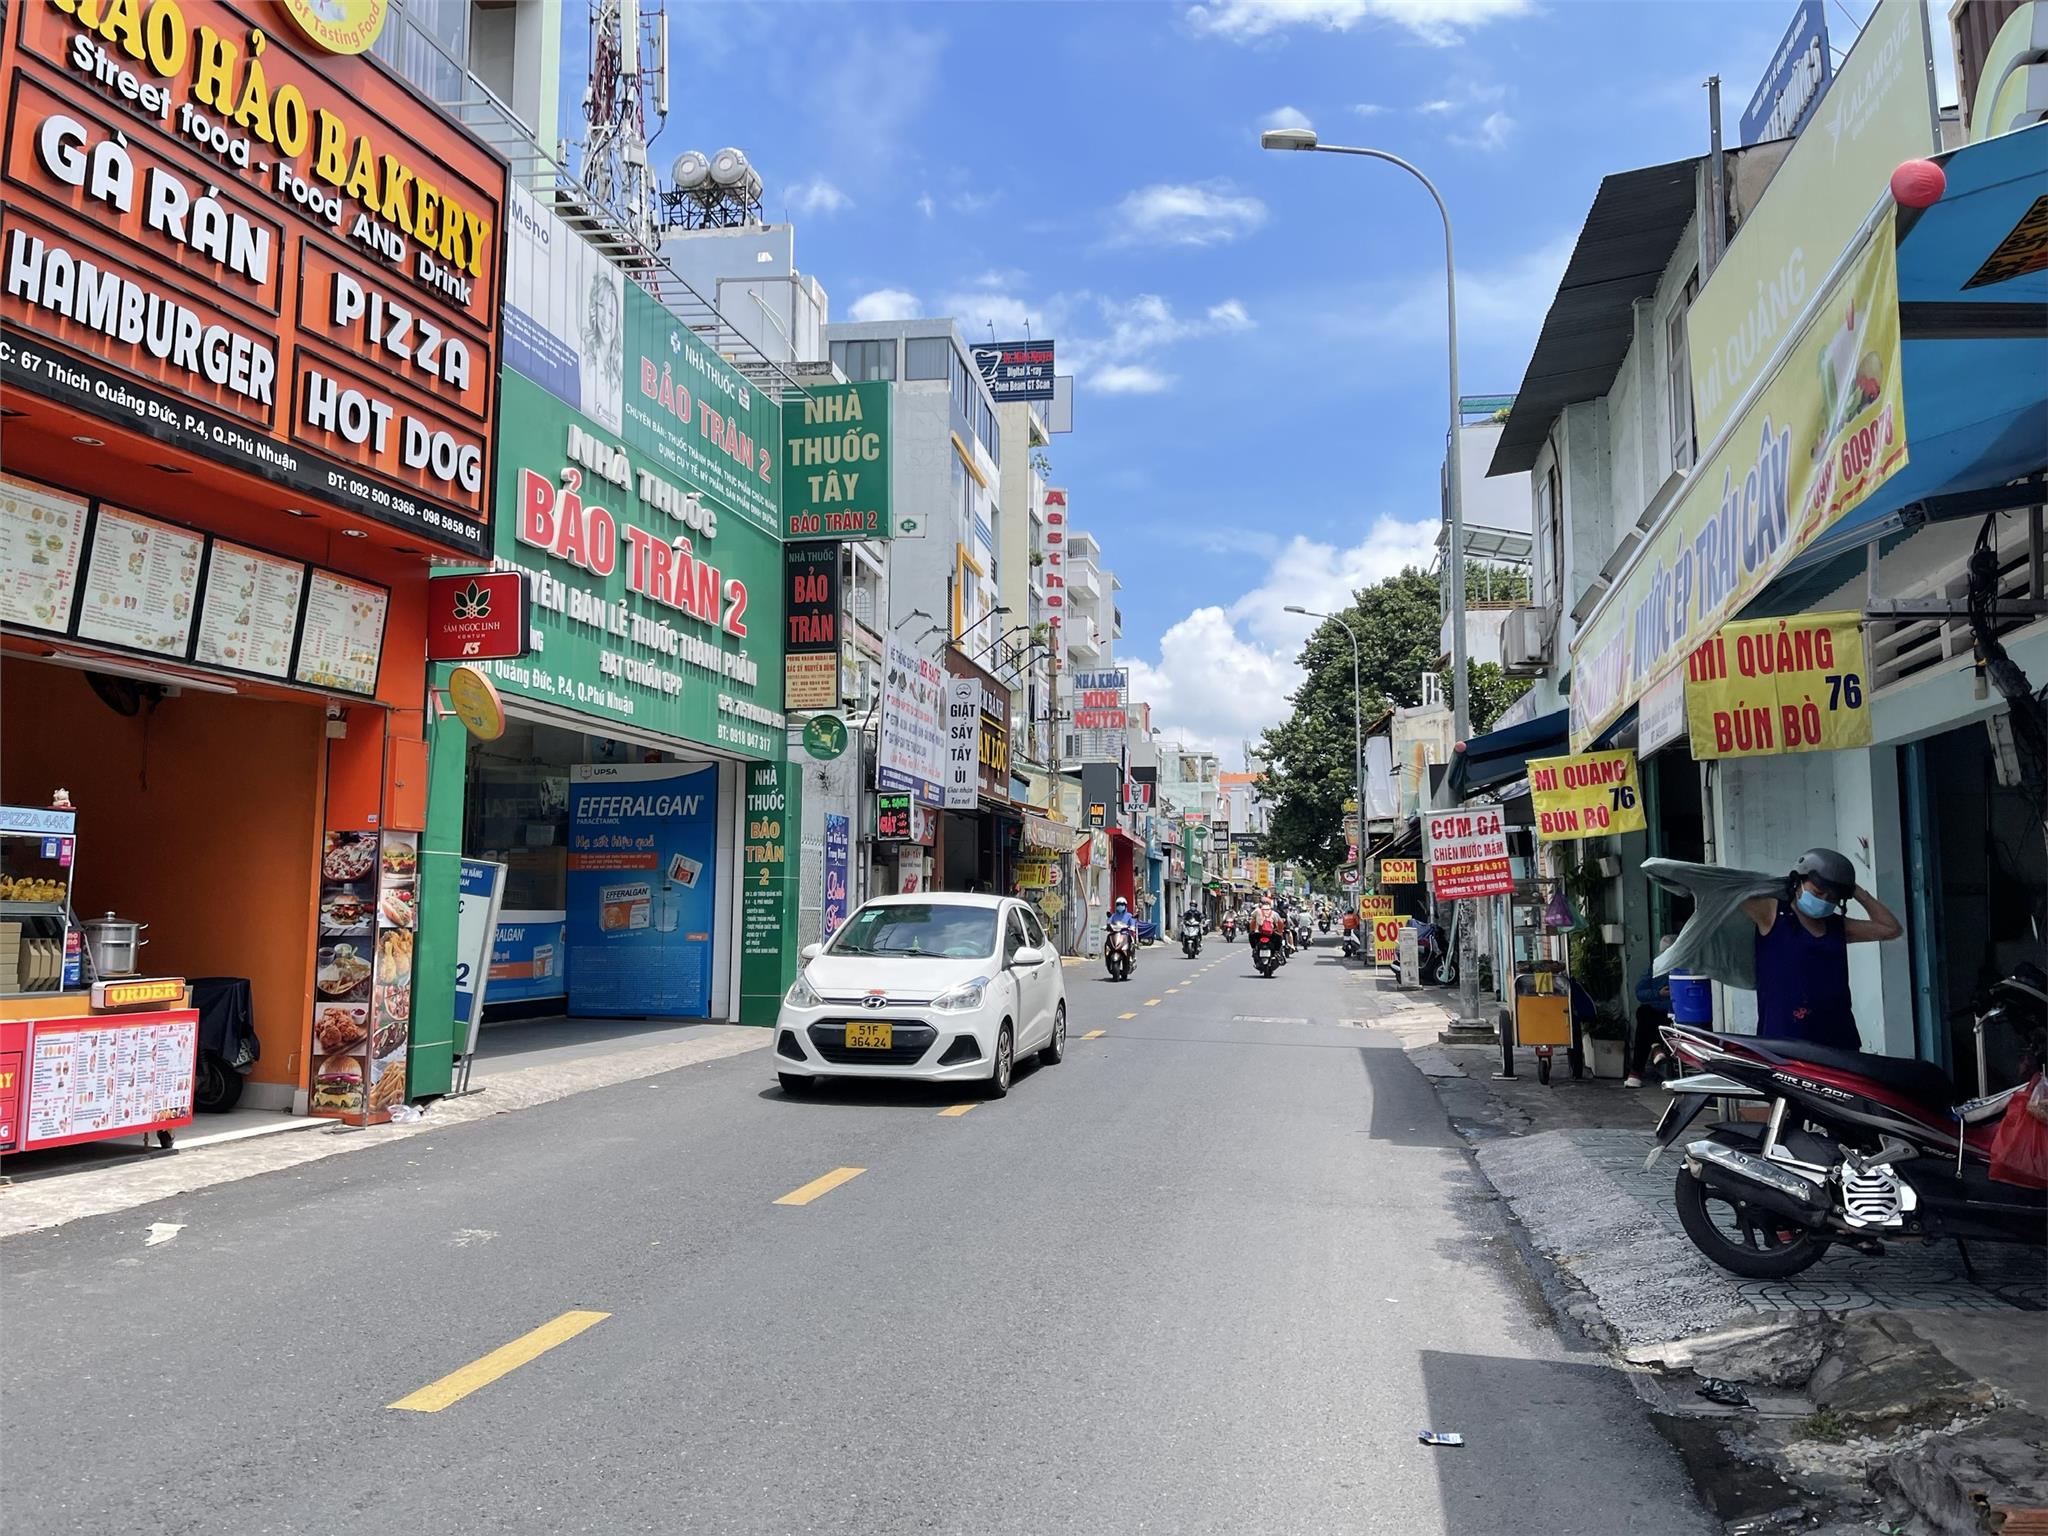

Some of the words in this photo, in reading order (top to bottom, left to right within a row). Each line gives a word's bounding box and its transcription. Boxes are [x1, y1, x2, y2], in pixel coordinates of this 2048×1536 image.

[313, 15, 360, 48] Tasting
[358, 0, 380, 39] Food
[195, 28, 308, 159] HẢO
[317, 109, 490, 279] BAKERY
[73, 33, 171, 119] Street
[182, 103, 250, 170] food
[278, 164, 342, 226] Food
[352, 211, 407, 264] AND
[419, 252, 471, 306] Drink
[39, 114, 135, 213] GÀ
[149, 167, 270, 285] RÁN
[8, 228, 276, 406] HAMBURGER
[334, 272, 470, 391] PIZZA
[685, 344, 706, 375] NHÀ
[706, 362, 736, 400] THUỐC
[1007, 366, 1025, 378] Digital
[1035, 379, 1051, 390] Scan
[21, 353, 42, 372] 67
[46, 360, 90, 394] Thích
[95, 379, 146, 418] Quảng
[148, 400, 181, 429] Đức,
[184, 414, 210, 440] P.4,
[213, 426, 254, 456] Q.Phú
[256, 442, 298, 473] Nhuận
[641, 355, 692, 425] BẢO
[697, 399, 754, 472] TRÂN
[758, 448, 772, 484] 2
[805, 389, 863, 425] NHÀ
[308, 371, 393, 452] HOT
[405, 415, 482, 492] DOG
[788, 427, 880, 467] THUỐC
[568, 424, 632, 492] NHÀ
[637, 466, 718, 540] THUỐC
[807, 469, 860, 504] TÂY
[327, 471, 347, 493] ĐT:
[350, 480, 370, 498] 092
[371, 485, 390, 506] 500
[392, 492, 415, 517] 3366
[423, 507, 441, 528] 098
[442, 514, 464, 535] 5858
[465, 523, 481, 541] 051
[1695, 466, 1741, 622] TRÁI
[1741, 415, 1793, 574] CÂY
[789, 509, 821, 535] BẢO
[825, 508, 864, 532] TRÂN
[866, 511, 878, 530] 2
[516, 467, 617, 578] BẢO
[621, 522, 723, 630] TRÂN
[723, 578, 749, 639] 2
[788, 550, 807, 563] NHÀ
[807, 548, 834, 562] THUỐC
[794, 567, 829, 605] BẢO
[481, 621, 501, 632] LINH
[567, 587, 607, 630] BÁN
[607, 600, 629, 637] LẺ
[629, 612, 679, 657] THUỐC
[678, 633, 724, 674] THÀNH
[722, 650, 758, 687] PHẨM
[789, 608, 834, 644] TRÂN
[1688, 630, 1727, 682] MÌ
[1737, 620, 1835, 679] QUẢNG
[600, 650, 624, 680] ĐẠT
[624, 658, 663, 690] CHUẨN
[662, 671, 684, 697] GPP
[496, 660, 530, 689] Quảng
[532, 672, 556, 696] Đức,
[606, 690, 635, 717] Nhuận
[1825, 673, 1863, 712] 76
[950, 702, 976, 721] GIẶT
[1714, 693, 1774, 753] BÚN
[1781, 694, 1822, 747] BÒ
[730, 727, 746, 745] 0918
[760, 736, 771, 752] 317
[951, 722, 974, 740] SẤY
[950, 743, 972, 761] TẨY
[593, 768, 618, 776] UPSA
[755, 764, 778, 786] NHÀ
[954, 766, 967, 783] ỦI
[1535, 766, 1558, 792] MÌ
[1563, 758, 1627, 789] QUẢNG
[577, 795, 700, 818] EFFERALGAN
[748, 788, 785, 812] THUỐC
[1128, 803, 1145, 811] KFC
[1609, 785, 1636, 812] 76
[0, 812, 40, 828] PIZZA
[43, 814, 70, 829] 44K
[750, 816, 781, 840] BẢO
[1432, 816, 1473, 840] CƠM
[1476, 811, 1502, 836] GÀ
[1540, 807, 1579, 835] BÚN
[1583, 802, 1611, 830] BÒ
[745, 841, 785, 863] TRÂN
[1434, 844, 1459, 862] CHIÊN
[759, 867, 770, 886] 2
[1382, 860, 1415, 873] CƠM
[605, 887, 648, 899] EFFERALGAN
[1361, 895, 1393, 909] CƠM
[456, 962, 470, 987] 2
[111, 982, 178, 1003] ORDER
[850, 1036, 887, 1048] 364.24
[858, 1025, 879, 1037] 51F
[1771, 1072, 1798, 1085] AIR
[1801, 1080, 1855, 1100] BLADE
